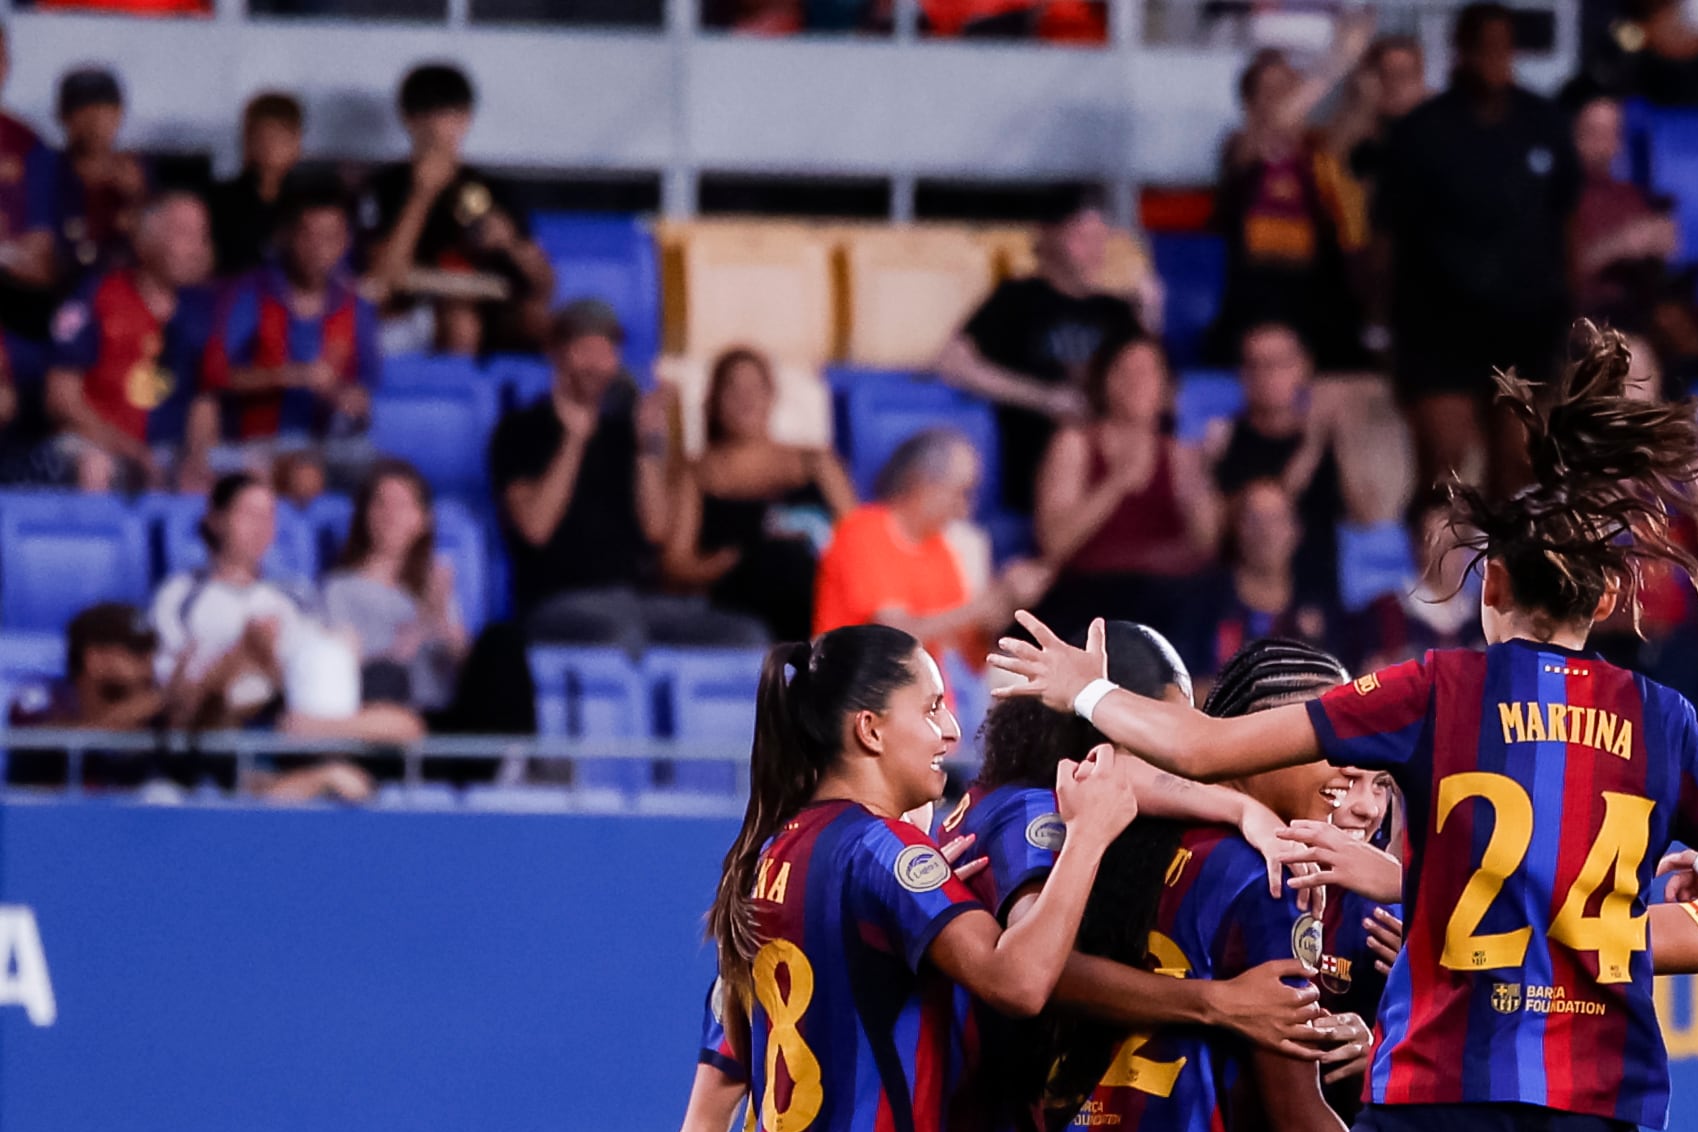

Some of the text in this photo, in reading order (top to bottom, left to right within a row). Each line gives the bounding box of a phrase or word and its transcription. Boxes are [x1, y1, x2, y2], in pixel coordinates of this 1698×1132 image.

[1498, 701, 1633, 761] MARTINA
[753, 858, 791, 904] KA
[1436, 771, 1656, 984] 24
